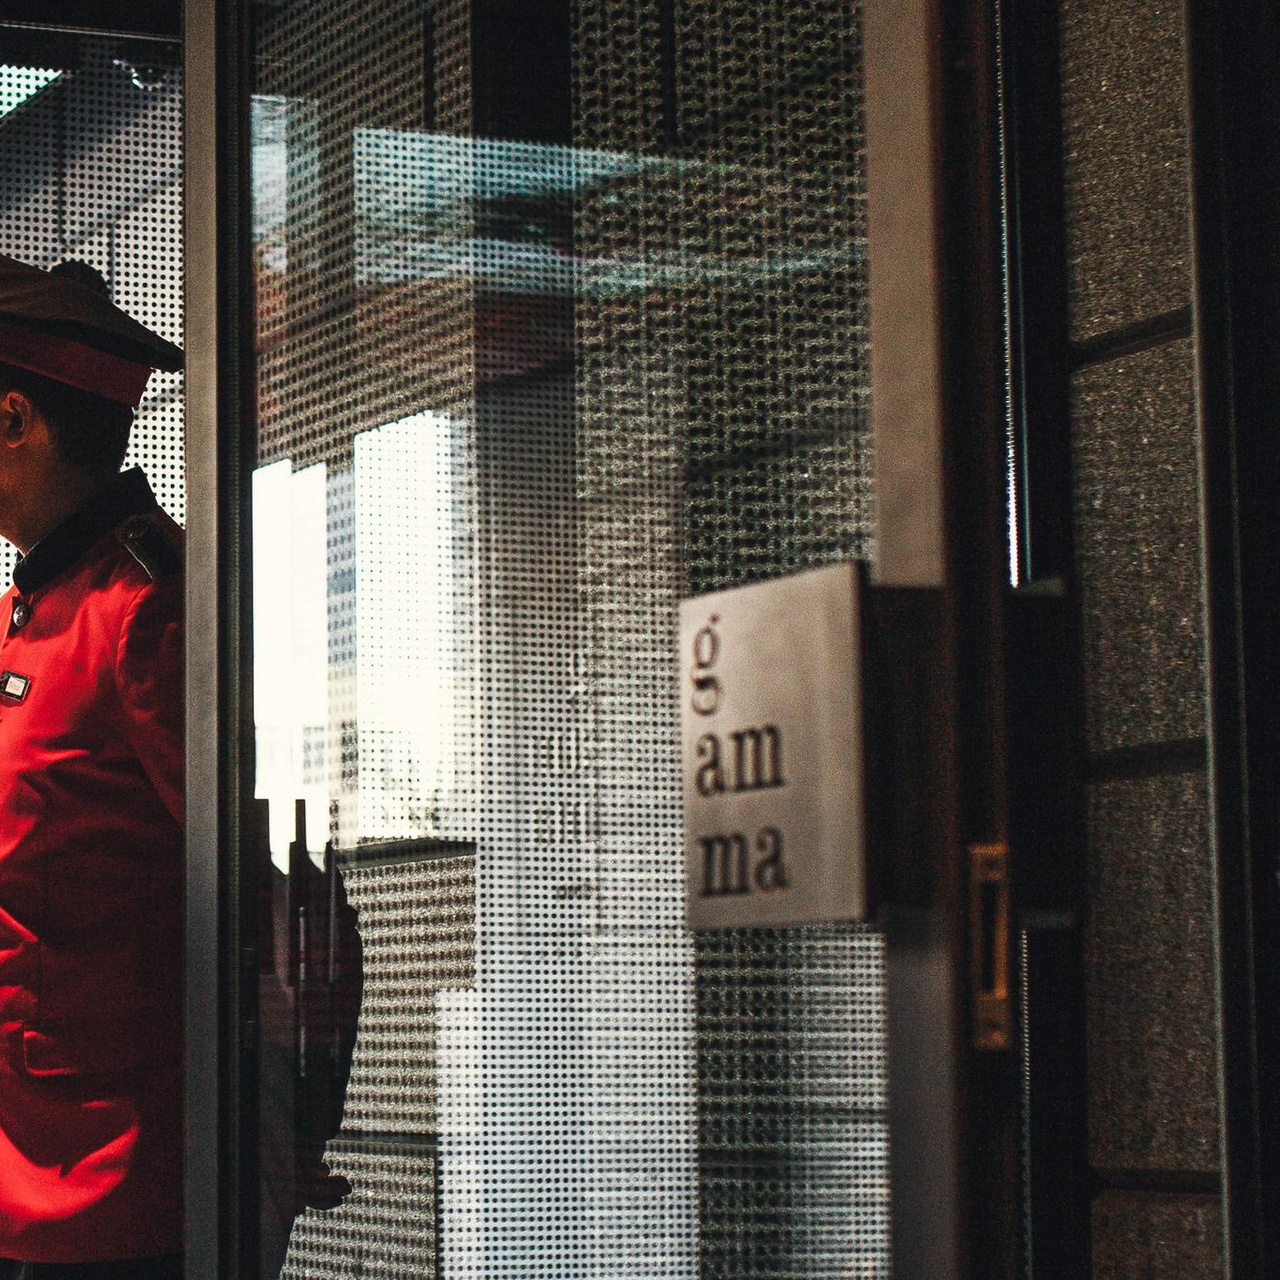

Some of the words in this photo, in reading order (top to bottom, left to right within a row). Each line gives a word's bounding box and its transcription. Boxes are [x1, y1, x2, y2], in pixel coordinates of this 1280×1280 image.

[690, 613, 721, 717] g
[695, 723, 786, 798] am
[698, 826, 789, 898] ma
